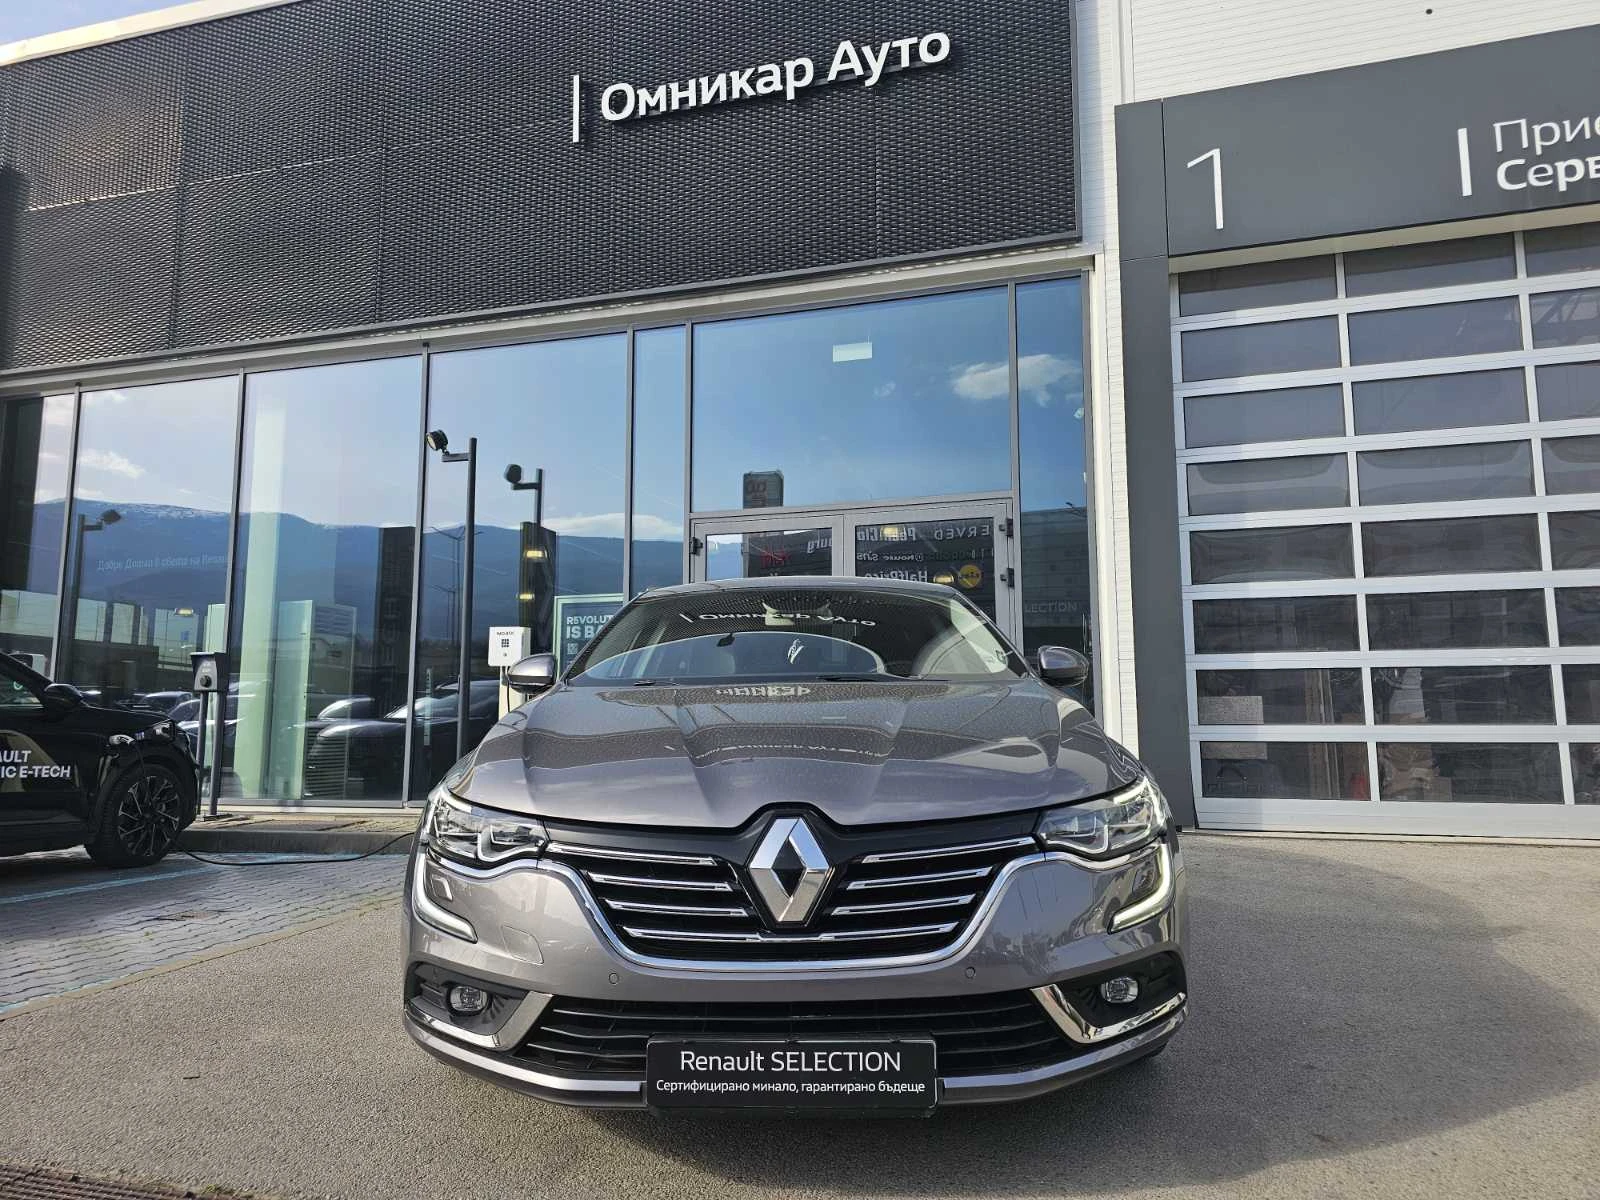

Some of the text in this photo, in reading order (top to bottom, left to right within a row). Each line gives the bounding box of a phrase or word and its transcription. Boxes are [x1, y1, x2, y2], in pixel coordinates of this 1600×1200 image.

[601, 32, 951, 122] Омникар Ауто
[1186, 147, 1225, 230] 1
[566, 626, 581, 639] IS
[19, 765, 71, 778] E-TECH
[680, 1051, 902, 1072] Renault SELECTION
[656, 1080, 926, 1095] Сертифицирано минало, гарантирано бъдеще
